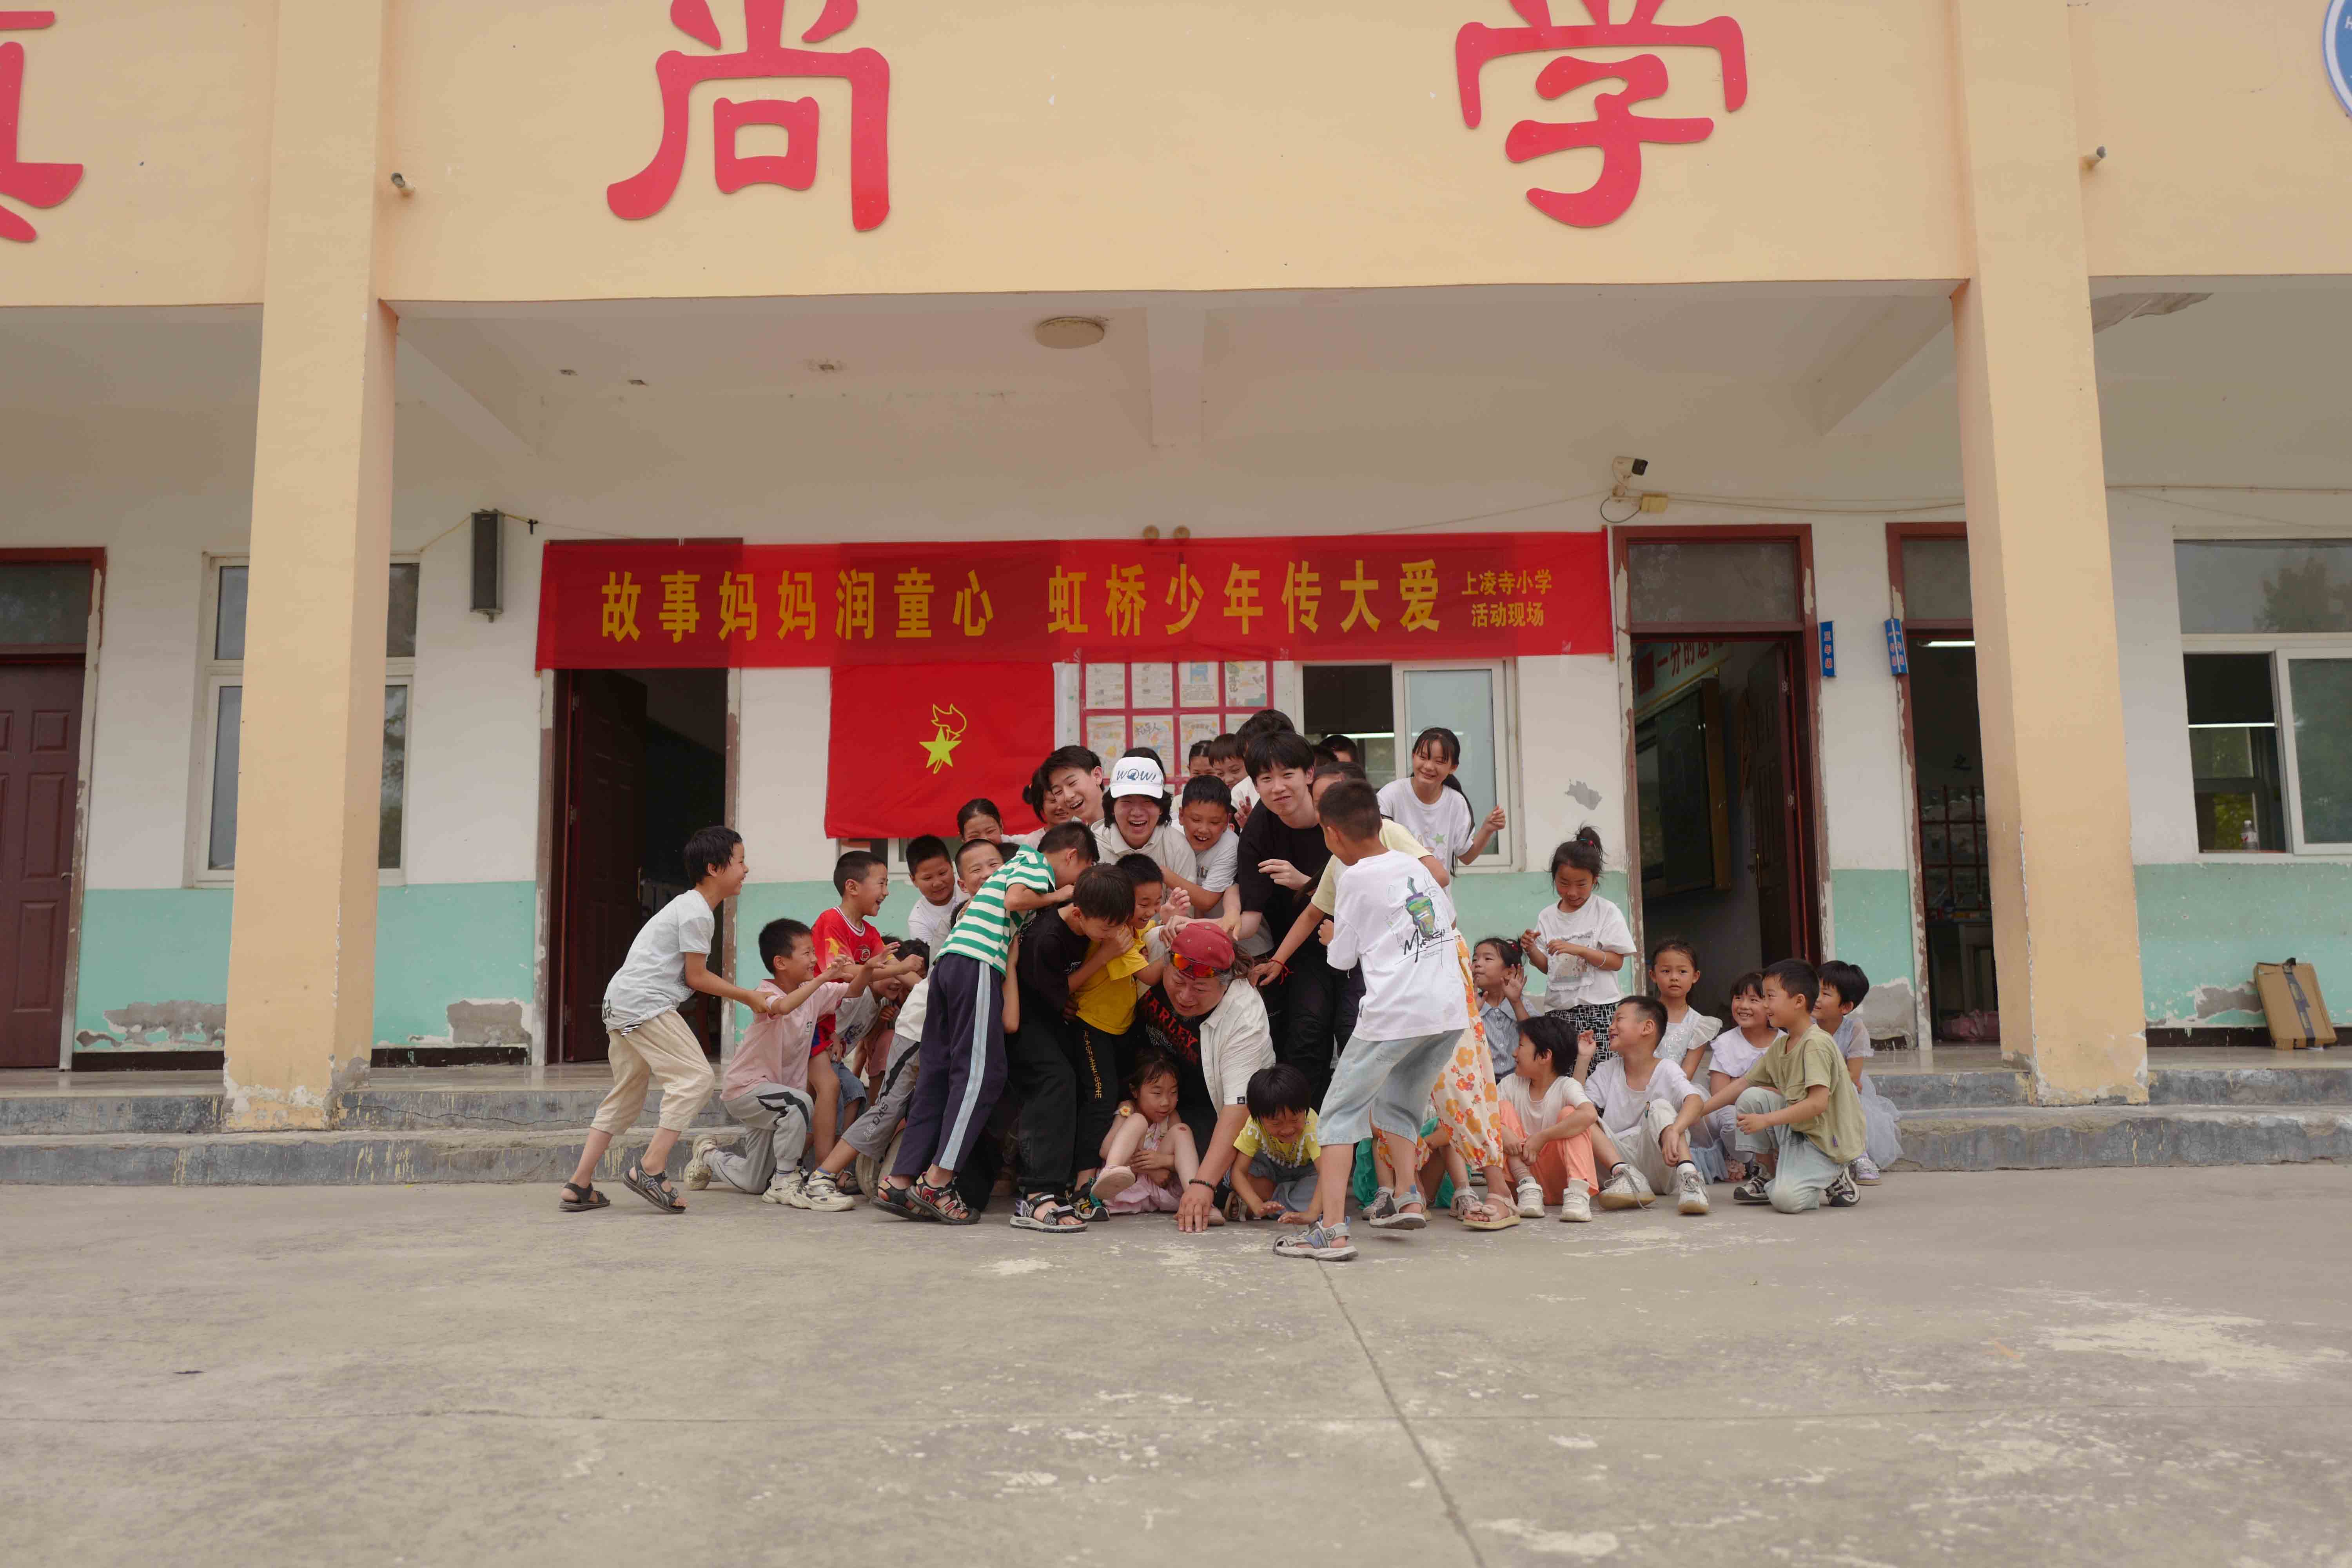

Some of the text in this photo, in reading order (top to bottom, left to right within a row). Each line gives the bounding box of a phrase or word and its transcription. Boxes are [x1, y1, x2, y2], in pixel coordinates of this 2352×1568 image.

[607, 0, 1748, 231] 尚 学
[1461, 569, 1552, 595] 上凌寺小学
[601, 558, 1440, 644] 故事妈妈润童心 虹桥少年传大爱
[1471, 601, 1544, 628] 活动现场
[1116, 768, 1156, 782] WOW!
[863, 1102, 889, 1141] SPORT
